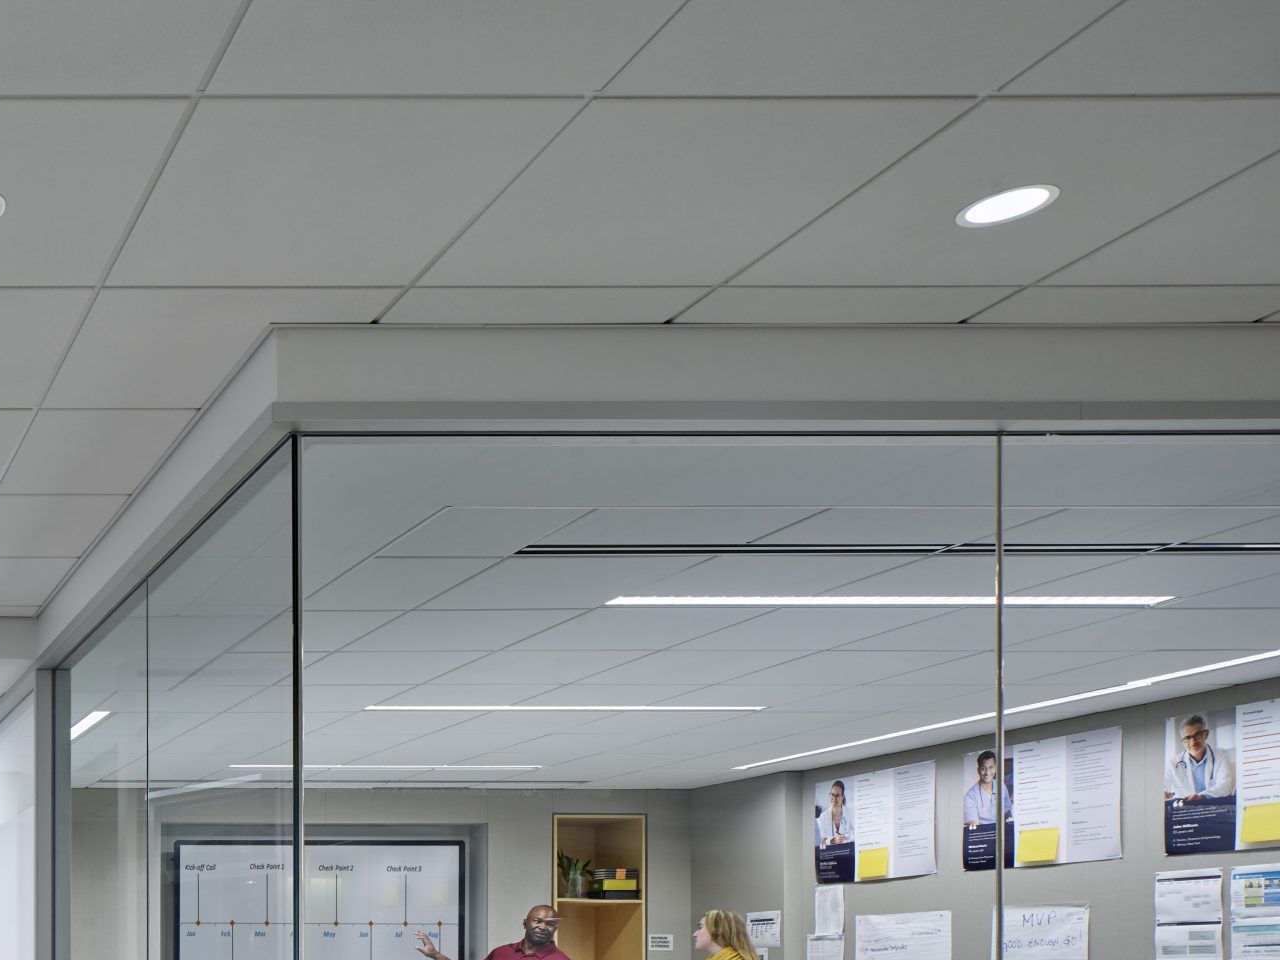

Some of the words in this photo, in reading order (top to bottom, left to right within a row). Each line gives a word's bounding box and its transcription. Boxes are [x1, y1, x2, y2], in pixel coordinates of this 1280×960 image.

[184, 864, 205, 872] Kick-off
[205, 863, 217, 871] Call
[318, 864, 333, 872] Check
[334, 864, 349, 872] Point
[349, 864, 354, 872] 2
[1022, 910, 1057, 928] MVP
[322, 931, 336, 939] May
